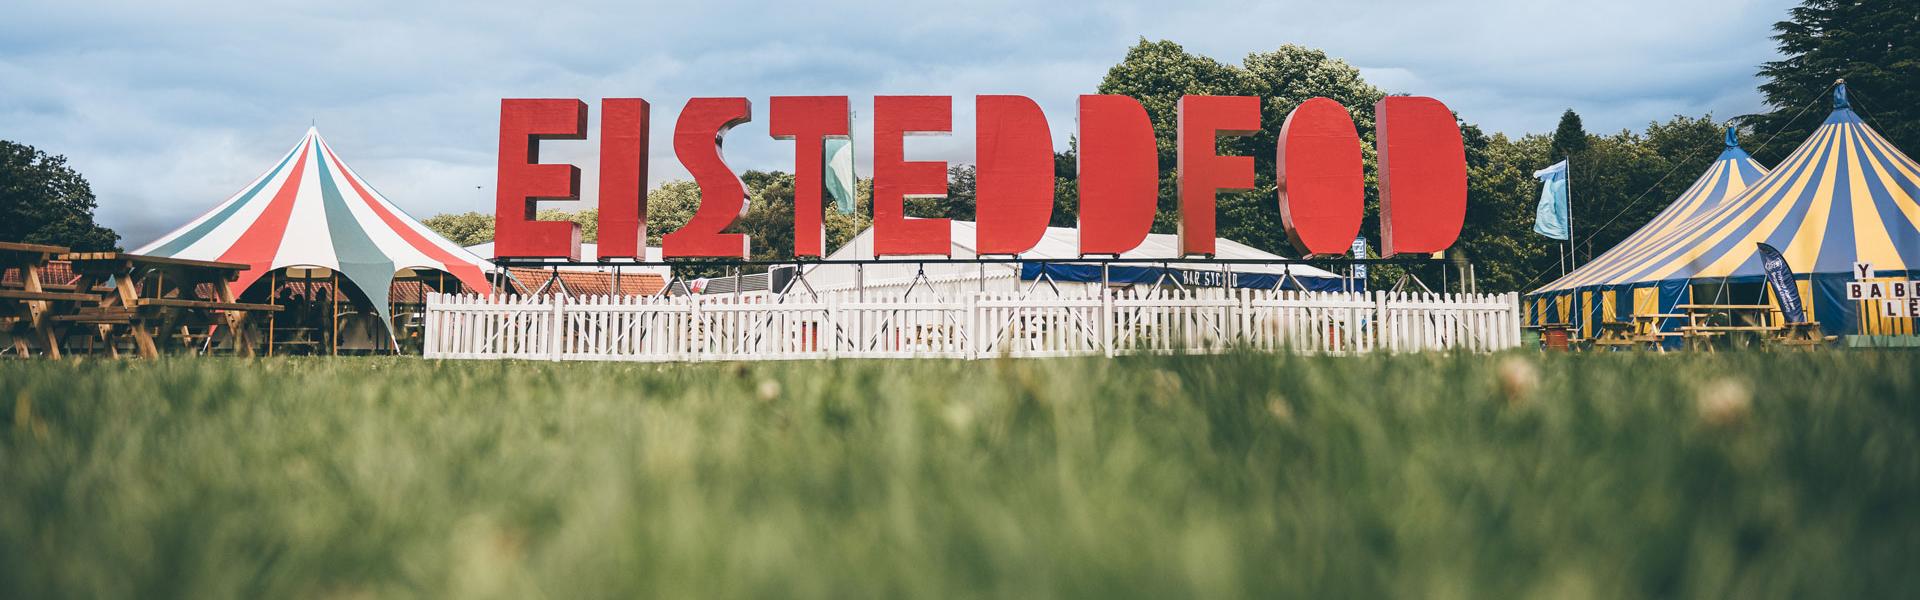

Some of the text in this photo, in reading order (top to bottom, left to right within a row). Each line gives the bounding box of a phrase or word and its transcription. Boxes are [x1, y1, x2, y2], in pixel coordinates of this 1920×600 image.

[494, 95, 1468, 260] EISTEDDFOD
[1183, 270, 1238, 288] BAR SYCD
[1858, 264, 1869, 278] Y
